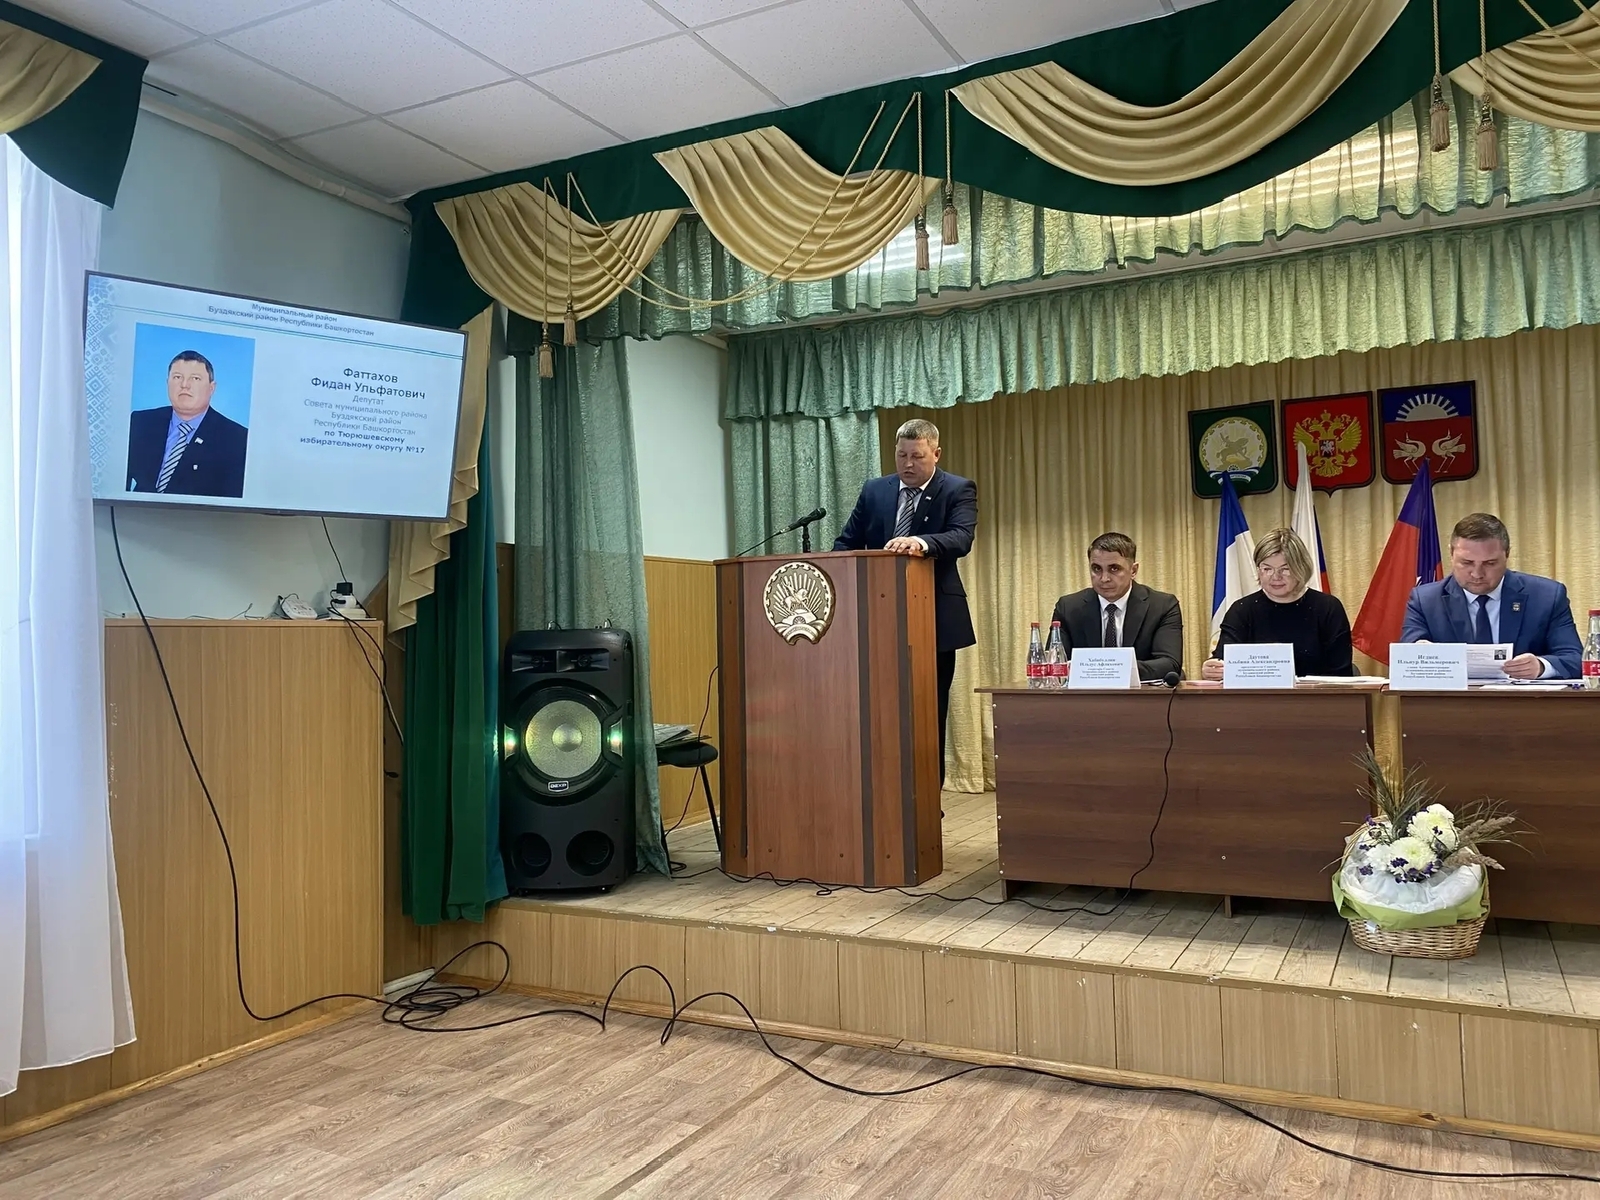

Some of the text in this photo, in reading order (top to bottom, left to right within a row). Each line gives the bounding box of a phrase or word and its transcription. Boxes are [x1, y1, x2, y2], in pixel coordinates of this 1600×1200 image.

[208, 305, 374, 336] Буздякский район Республики Башкортостан
[251, 303, 338, 323] Муниципальный район
[343, 367, 398, 383] Фаттахов
[311, 377, 426, 399] Фидан Ульфатович
[304, 398, 428, 419] Совета муниципального района
[352, 395, 384, 405] Депутат
[331, 411, 402, 425] Буздякский район
[313, 418, 416, 436] Республики Башкортостан
[300, 437, 425, 454] избирательному округу №17
[338, 430, 405, 444] Тюрюшевскому
